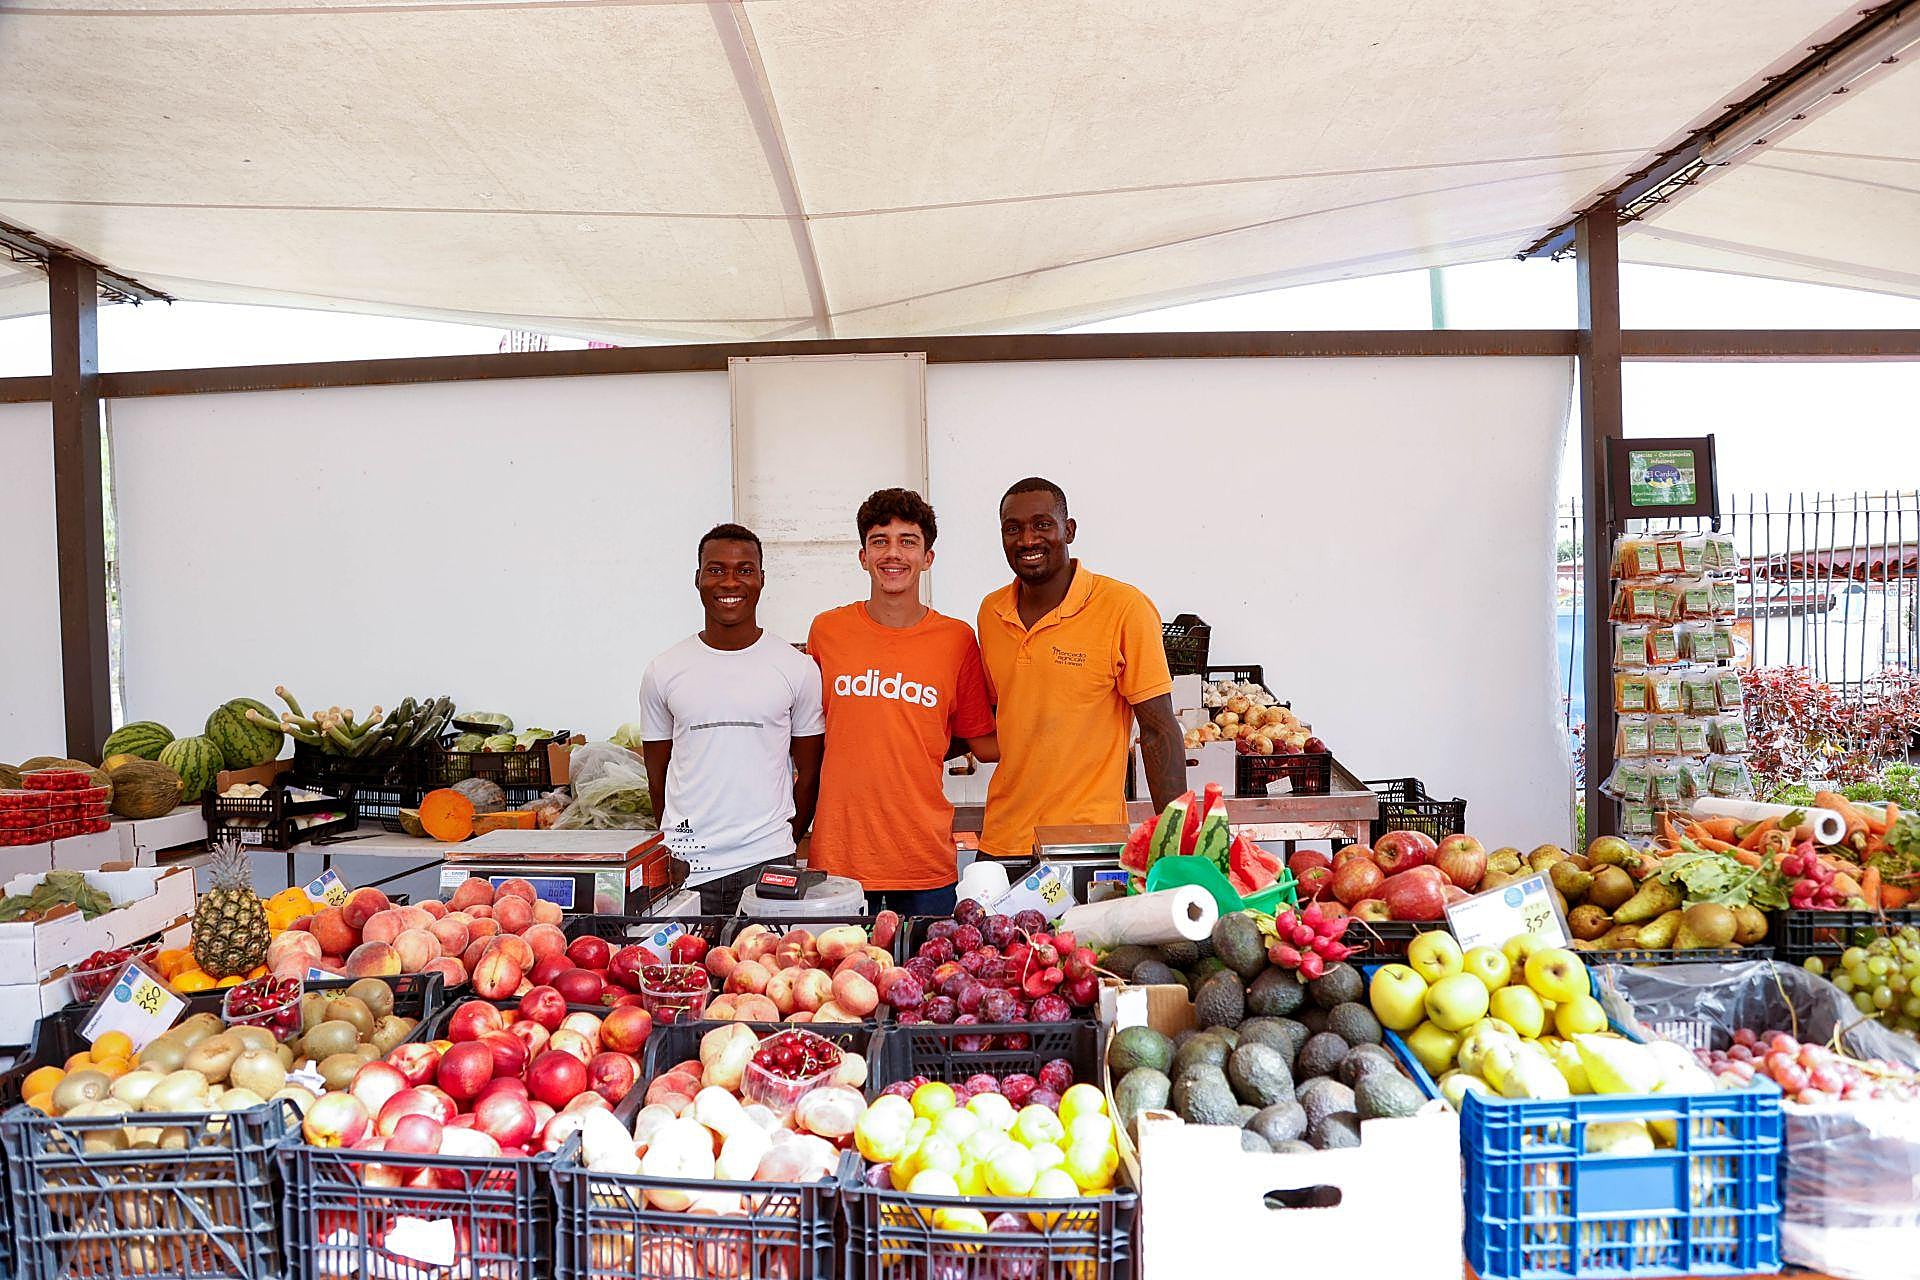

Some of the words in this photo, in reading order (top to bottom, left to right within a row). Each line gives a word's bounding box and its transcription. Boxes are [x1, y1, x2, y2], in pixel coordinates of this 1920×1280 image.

[834, 669, 938, 708] adidas
[1042, 882, 1061, 904] 3,50
[1524, 910, 1551, 934] 3,50
[139, 986, 160, 1014] 3,50
